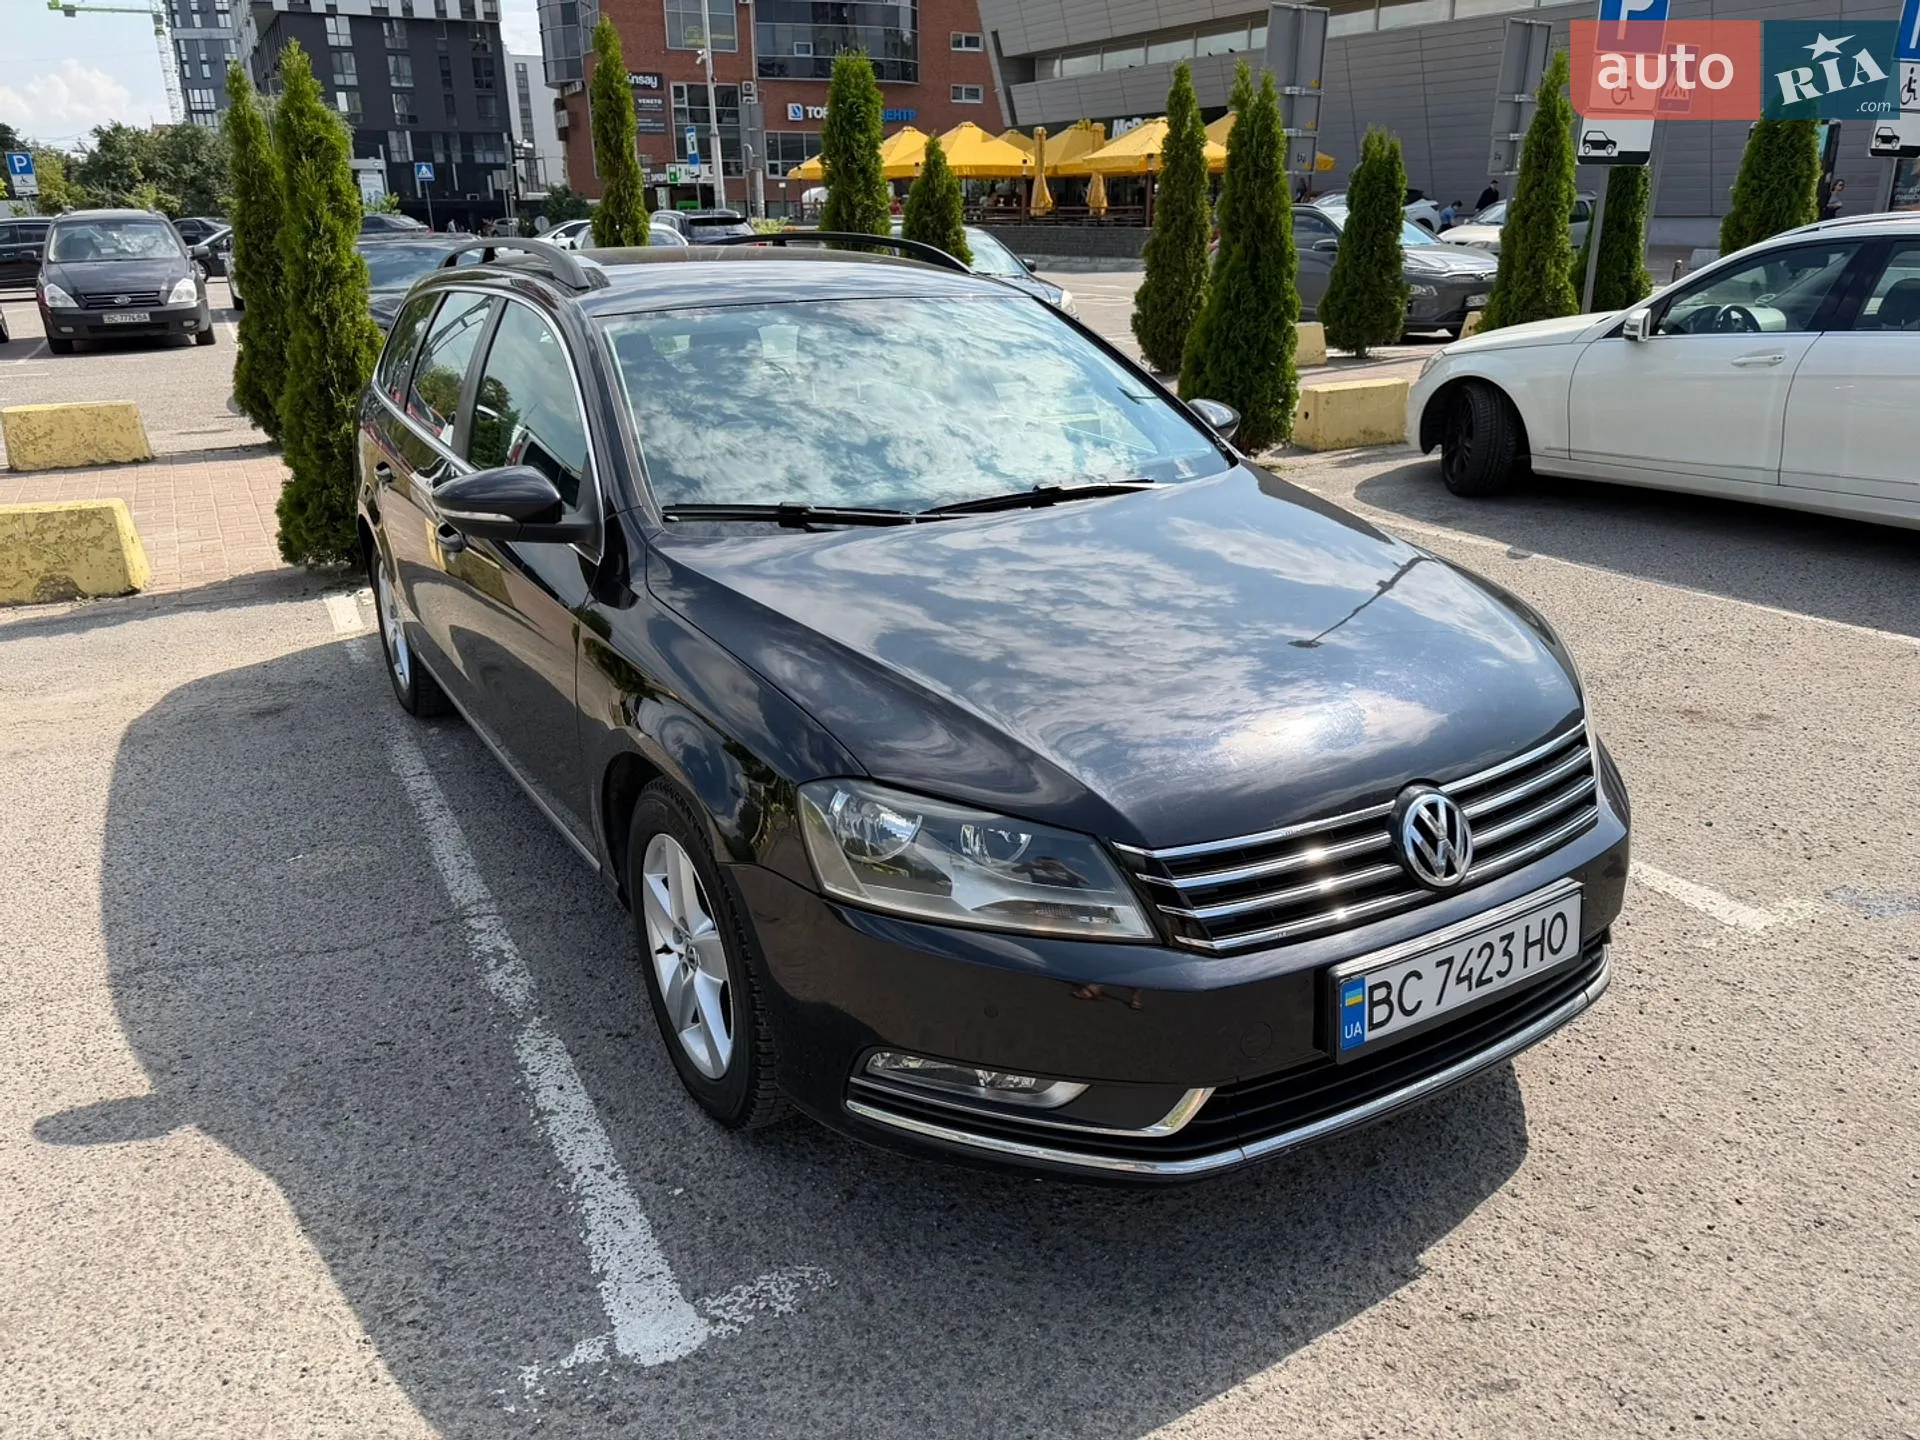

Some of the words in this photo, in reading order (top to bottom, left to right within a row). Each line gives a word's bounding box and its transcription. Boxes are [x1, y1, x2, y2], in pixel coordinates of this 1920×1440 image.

[806, 106, 828, 119] ТОР
[1112, 117, 1143, 139] McD
[13, 155, 27, 173] P
[1367, 969, 1423, 1032] BC
[1435, 931, 1515, 1006] 7423
[1523, 911, 1568, 969] HO
[1344, 1021, 1362, 1039] UA
